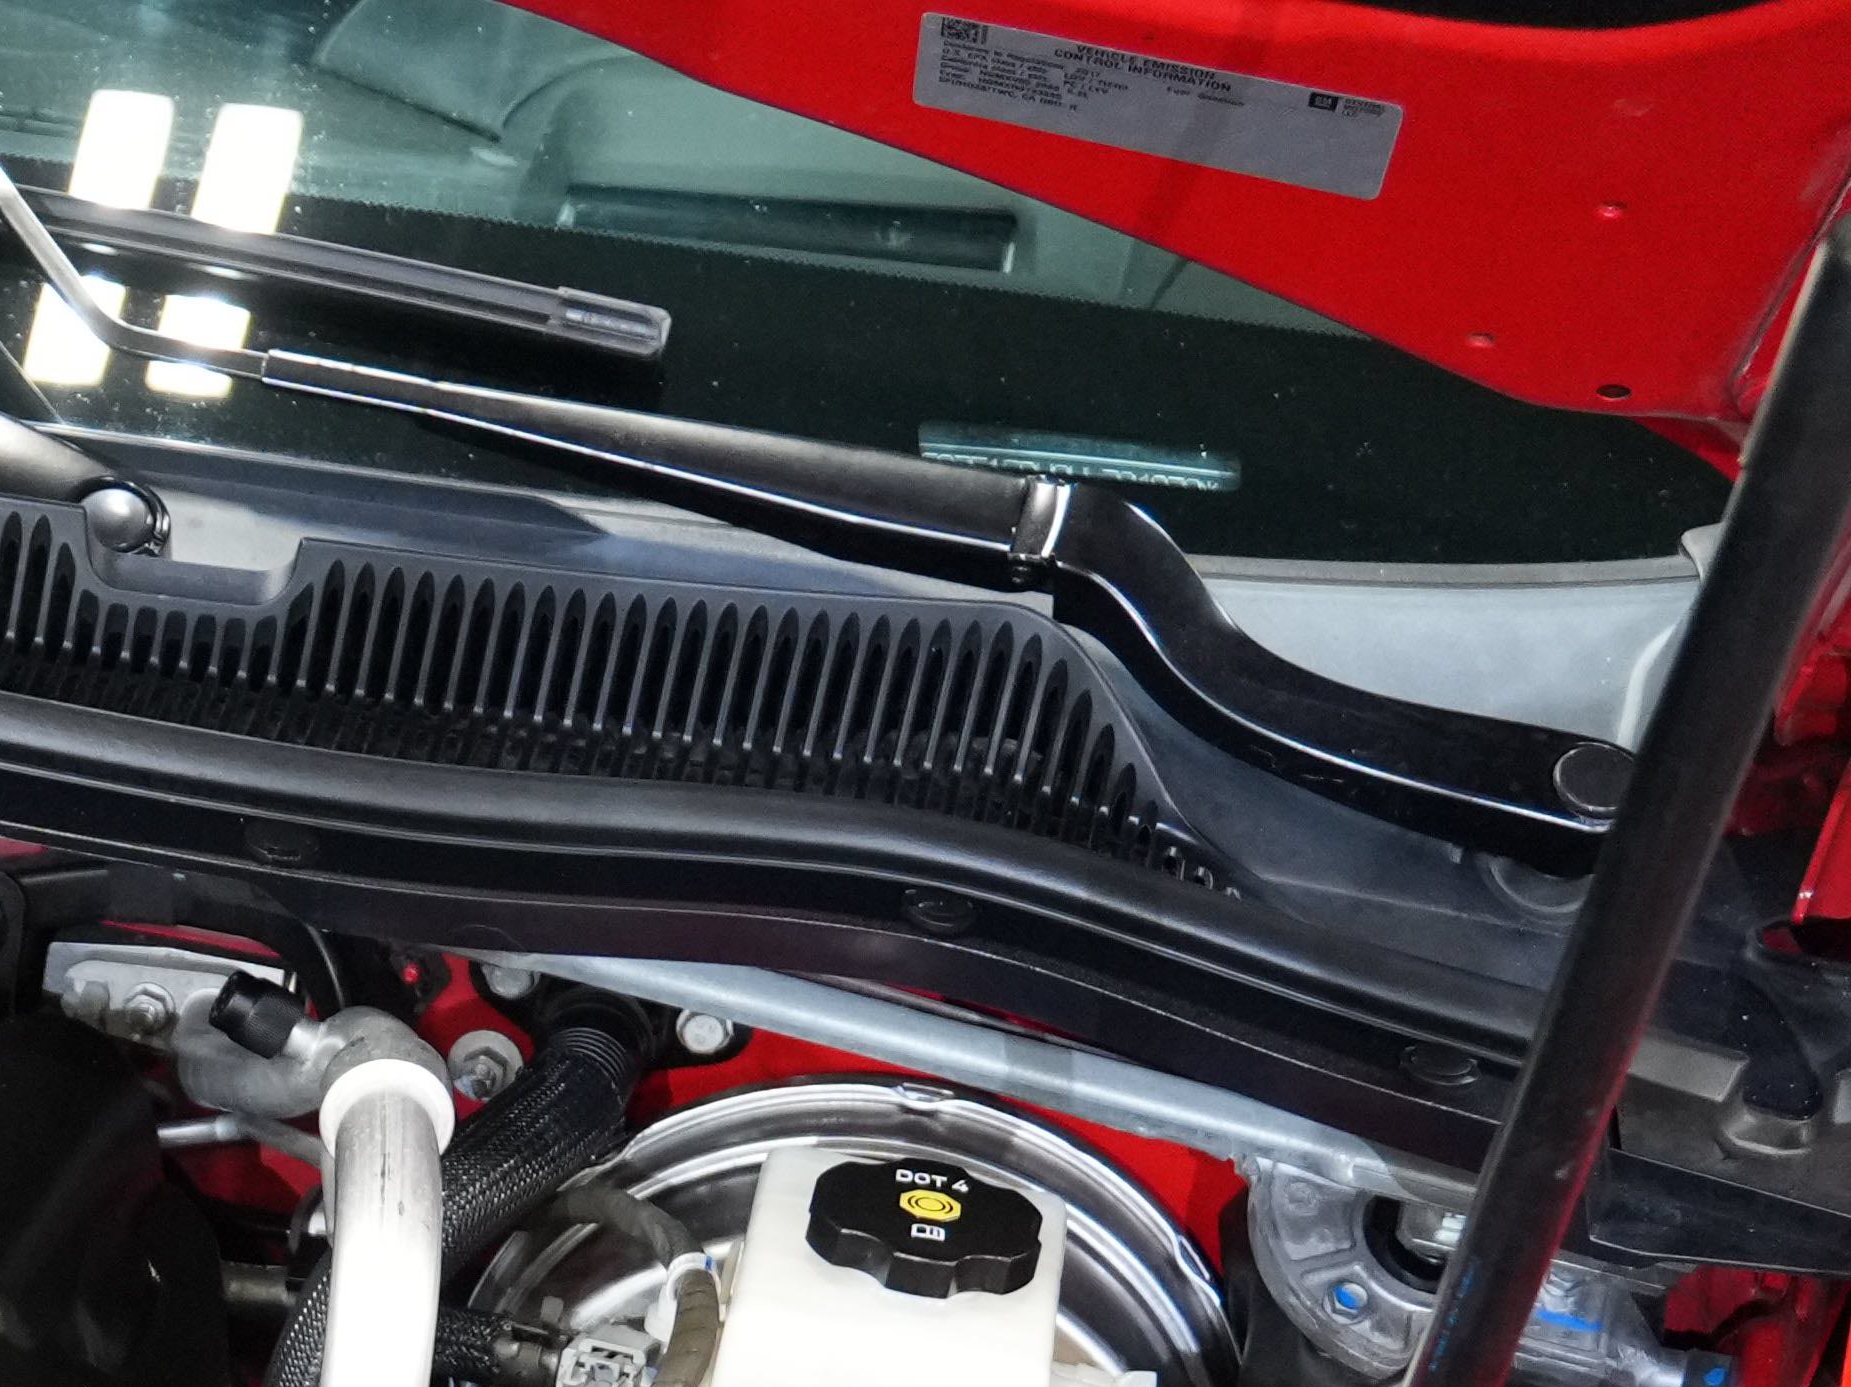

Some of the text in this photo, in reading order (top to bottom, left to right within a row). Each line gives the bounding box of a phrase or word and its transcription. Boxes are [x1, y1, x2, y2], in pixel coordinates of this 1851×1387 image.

[1054, 49, 1122, 71] CONTROL
[1127, 64, 1232, 93] INFORMATION
[1076, 44, 1216, 80] VEHICLE EMISSION
[895, 1168, 969, 1193] DOT 4
